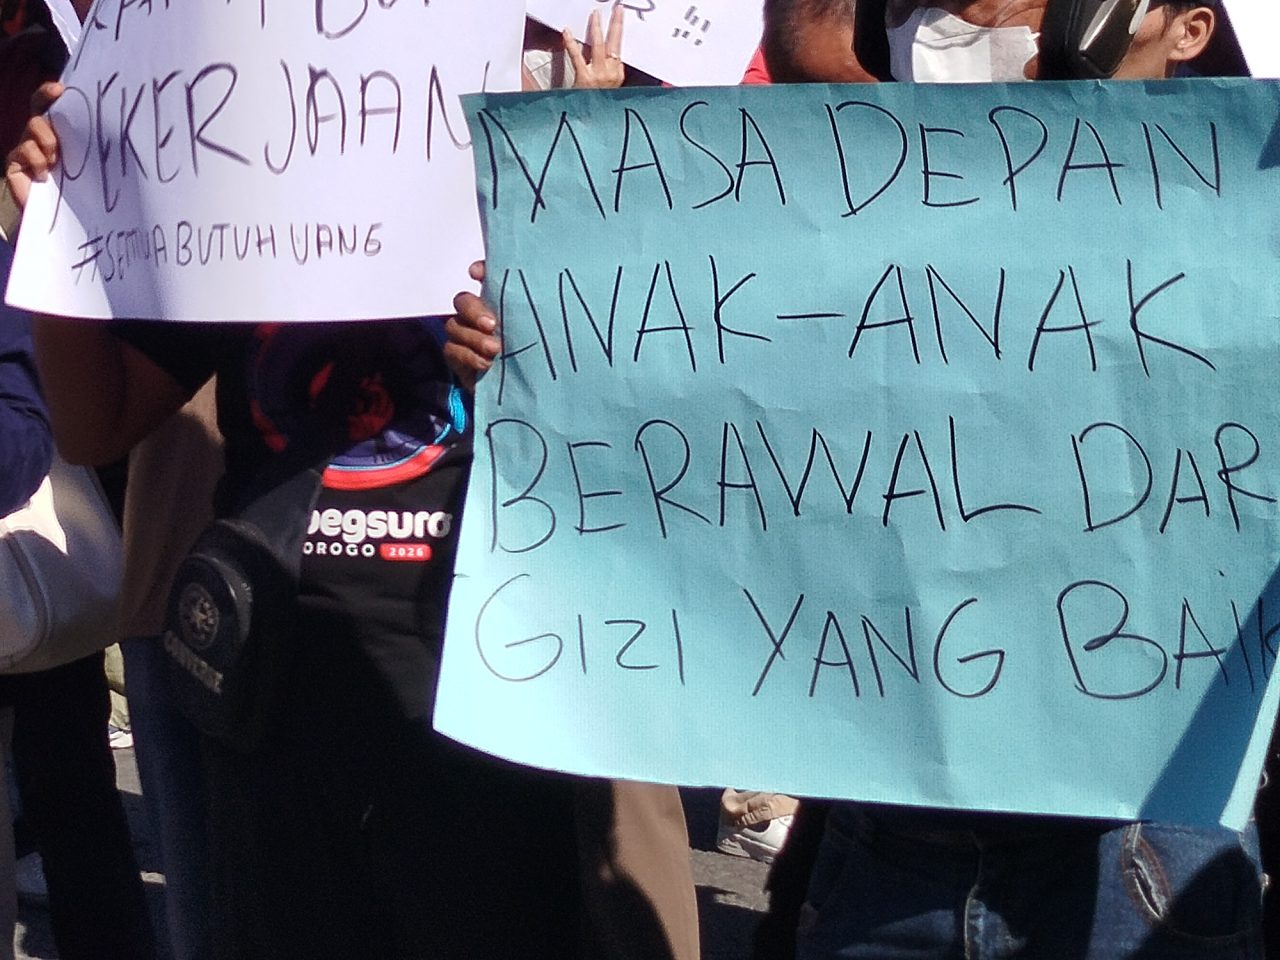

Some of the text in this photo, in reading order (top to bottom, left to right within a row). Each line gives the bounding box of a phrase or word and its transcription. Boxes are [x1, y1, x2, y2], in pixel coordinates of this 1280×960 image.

[476, 100, 1222, 223] MASA DEPAN
[495, 255, 1217, 406] ANAK-ANAK
[484, 415, 1042, 554] BERAWAL
[475, 573, 685, 686] GIZI
[743, 586, 1005, 700] YANG
